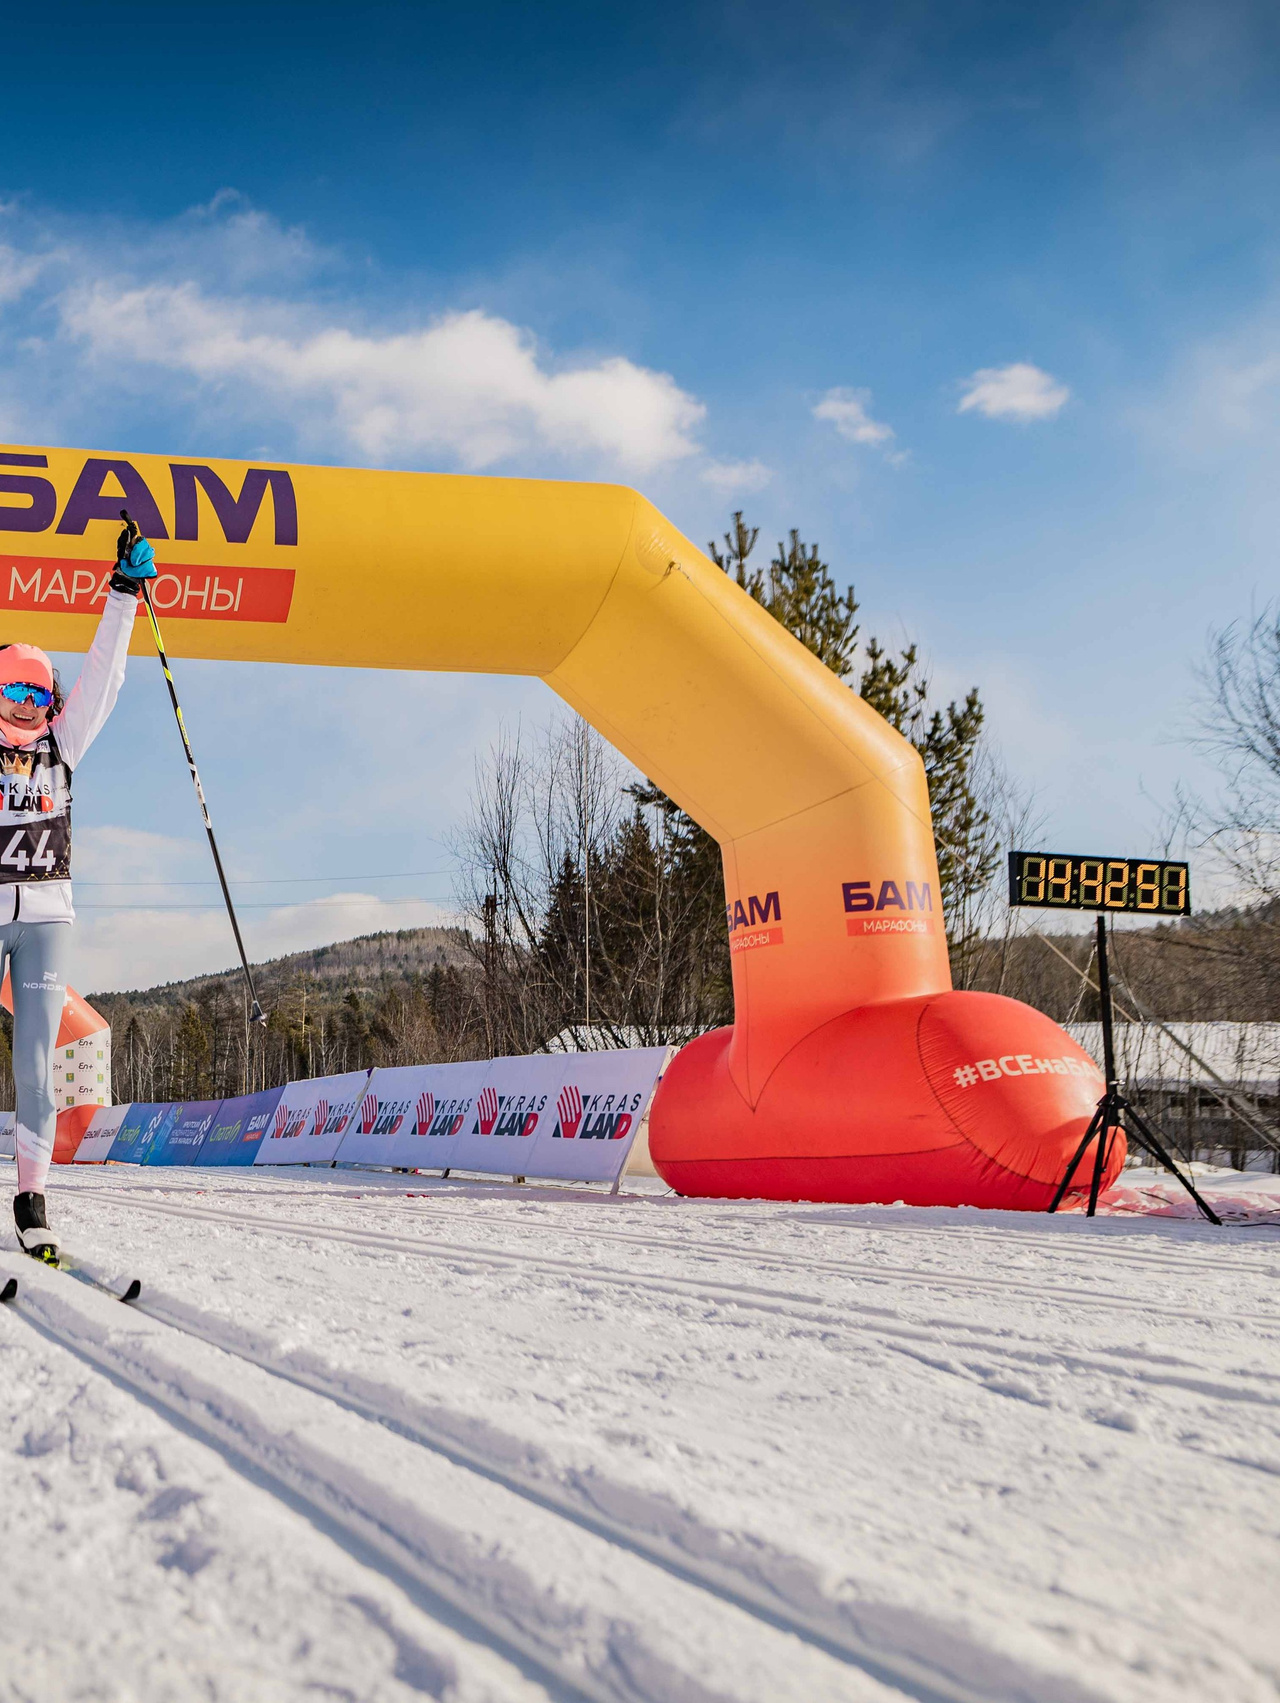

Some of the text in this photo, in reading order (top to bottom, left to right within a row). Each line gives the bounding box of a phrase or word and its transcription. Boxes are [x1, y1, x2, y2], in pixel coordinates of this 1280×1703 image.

[8, 566, 244, 613] МАРАОНЫ
[9, 782, 51, 795] KRAS
[8, 794, 54, 812] LAND
[842, 881, 933, 913] БАМ
[863, 918, 928, 934] МАРАФОНЫ
[331, 1101, 356, 1117] KRAS
[381, 1100, 412, 1115] KRAS
[440, 1098, 473, 1114] KRAS
[500, 1095, 548, 1111] KRAS
[589, 1093, 642, 1112] KRAS
[289, 1107, 312, 1121] KRAS
[282, 1120, 306, 1139] LAND
[322, 1115, 348, 1136] LAND
[372, 1114, 404, 1135] LAND
[428, 1113, 464, 1136] LAND
[493, 1112, 539, 1137] LAND
[579, 1113, 632, 1140] LAND
